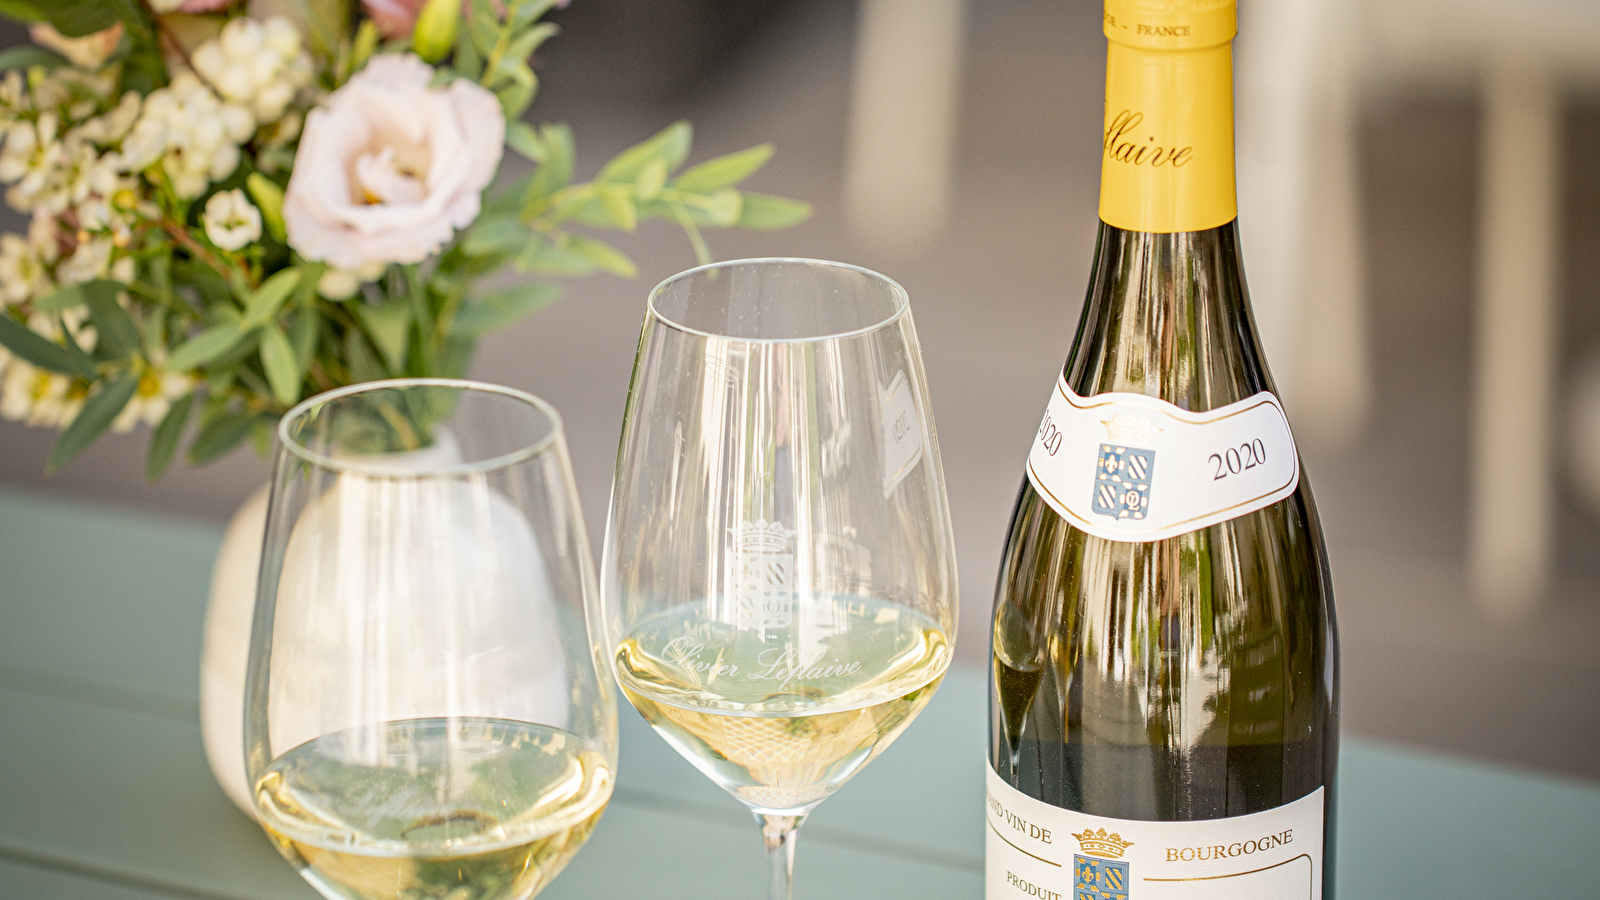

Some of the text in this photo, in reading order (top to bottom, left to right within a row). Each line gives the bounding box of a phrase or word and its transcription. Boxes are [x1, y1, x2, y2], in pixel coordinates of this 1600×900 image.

[1137, 24, 1191, 37] FRANCE
[1208, 438, 1267, 481] 2020
[661, 635, 862, 690] Olivier Leflaive
[1005, 808, 1027, 834] VIN
[1030, 823, 1053, 845] DE
[1165, 829, 1294, 862] BOURGOGNE
[1006, 870, 1061, 900] PRODUIT
